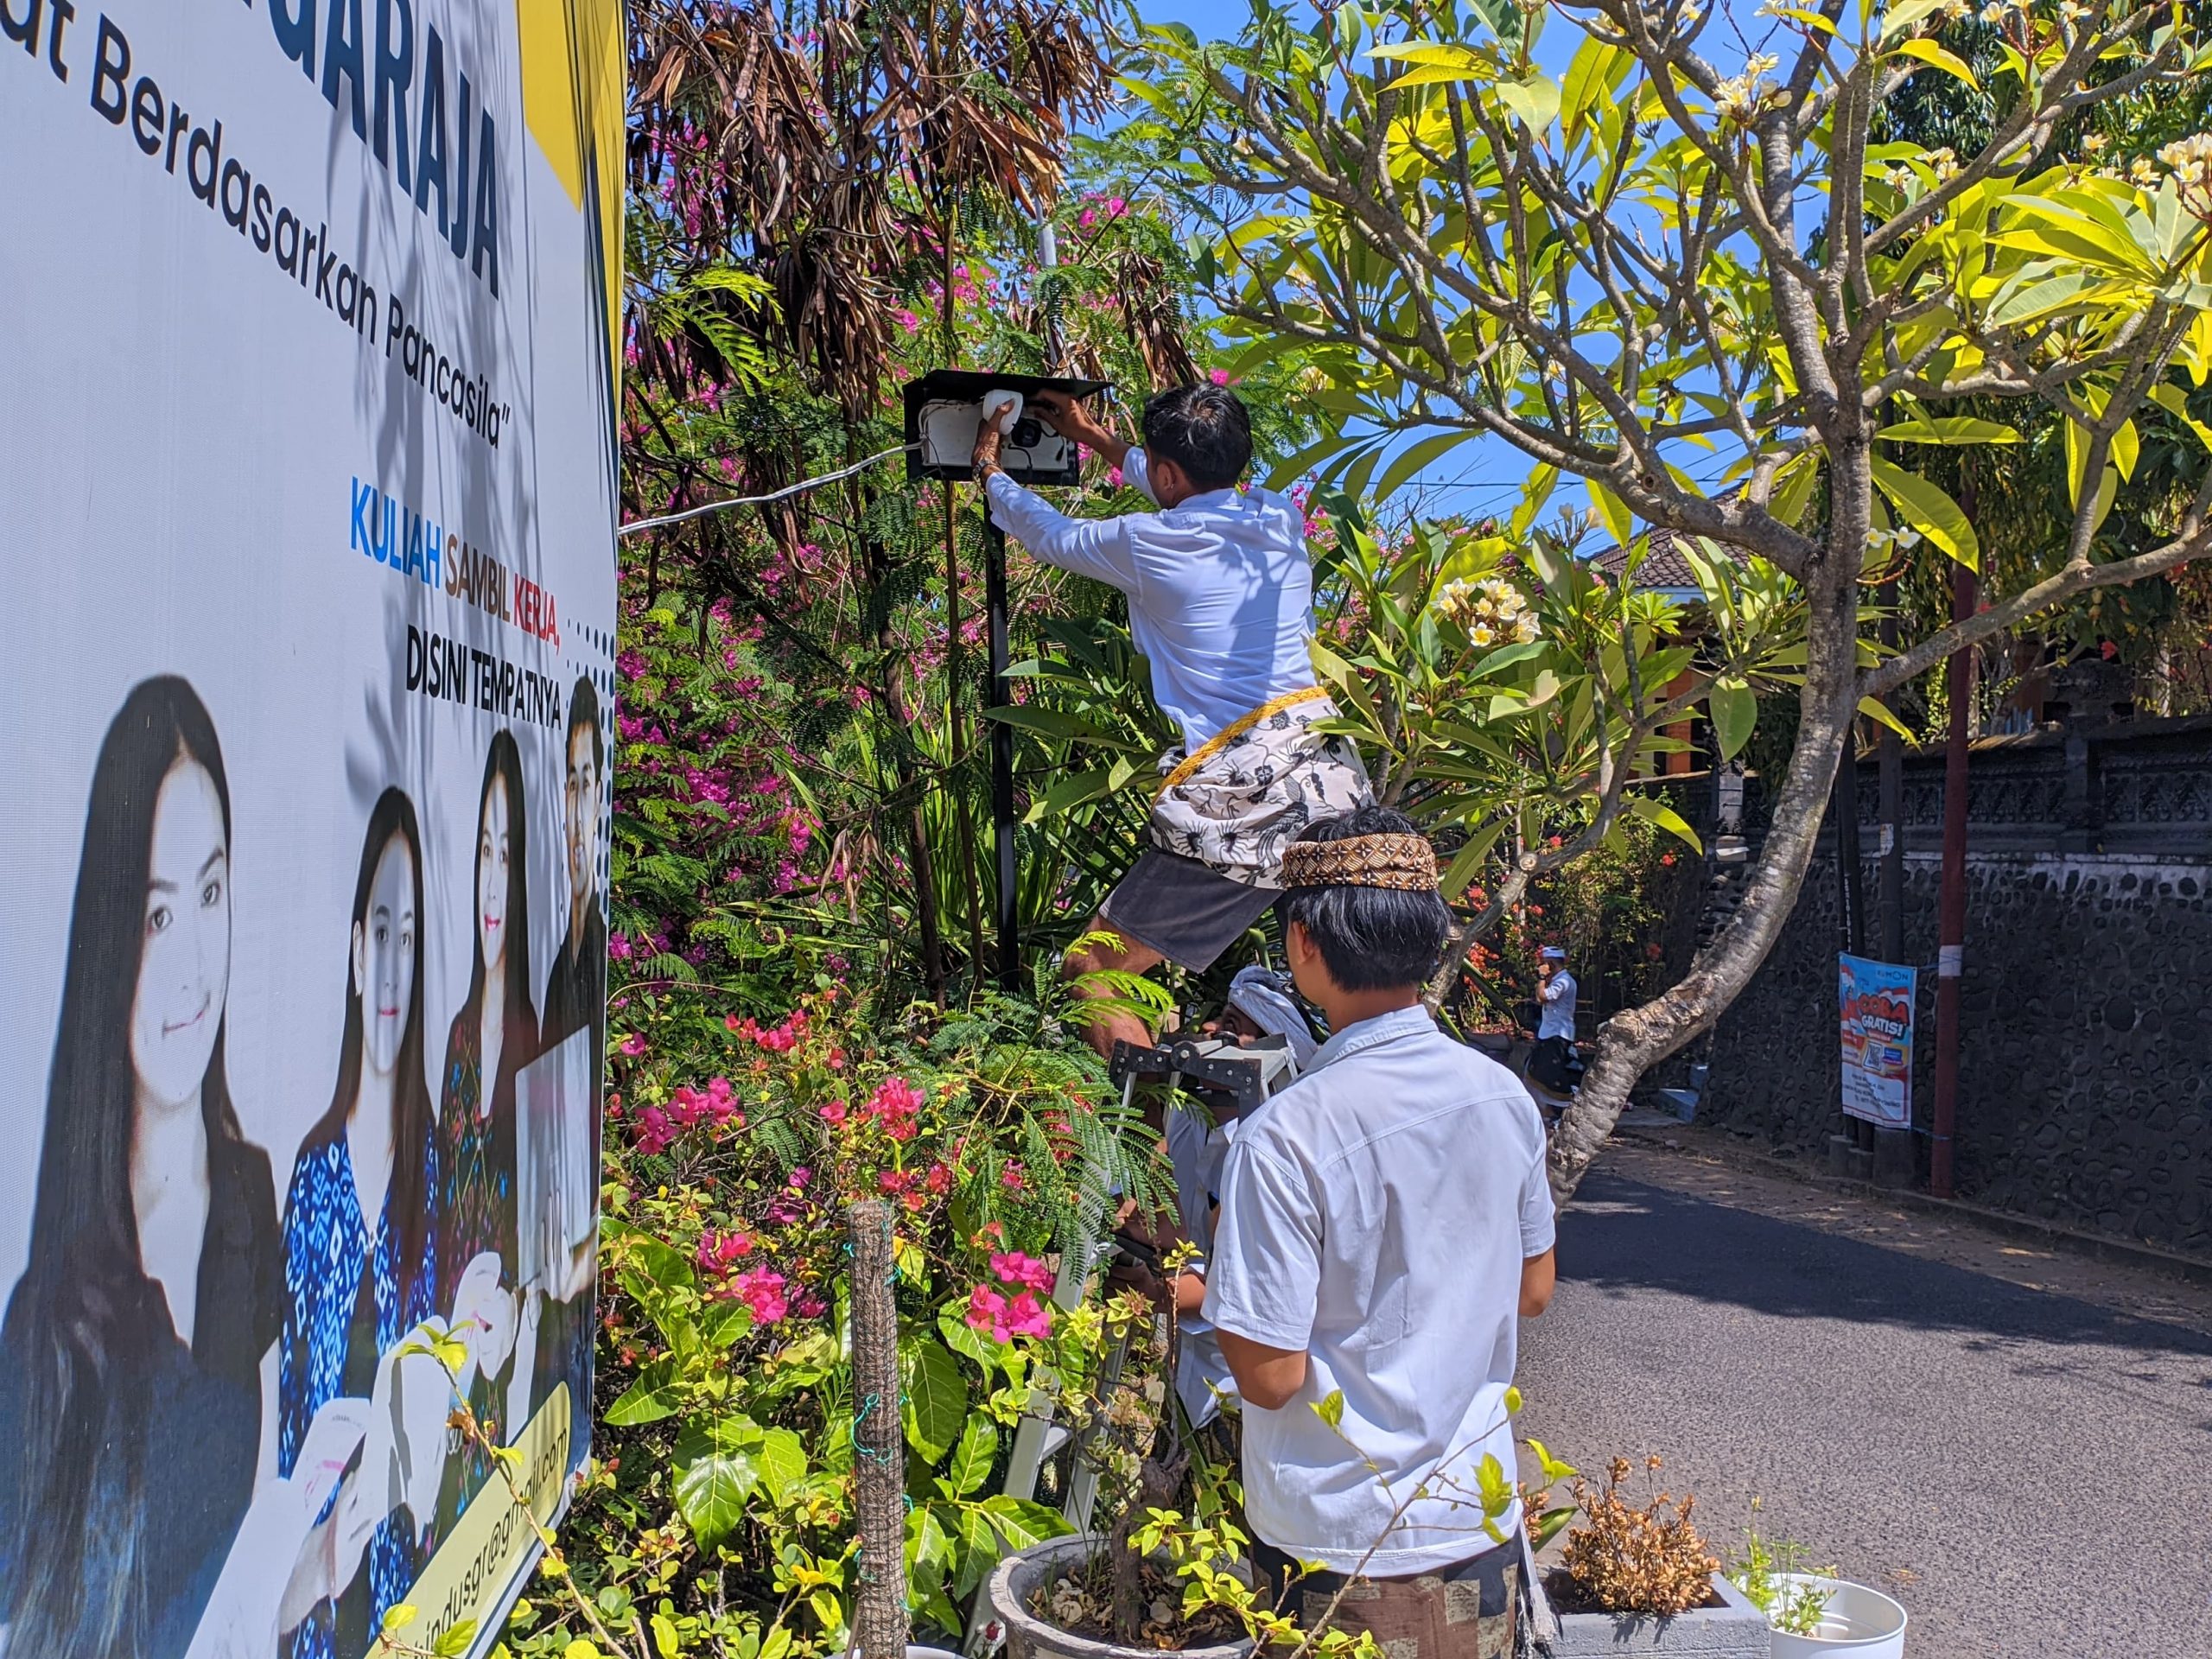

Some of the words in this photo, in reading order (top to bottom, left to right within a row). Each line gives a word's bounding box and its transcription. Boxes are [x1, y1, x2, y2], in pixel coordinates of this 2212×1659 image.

[91, 12, 378, 346] Berdasarkan
[385, 293, 511, 449] Pancasila"
[351, 475, 441, 588] KULIAH
[445, 533, 511, 622] SAMBIL
[513, 573, 561, 656] KERJA,
[406, 624, 467, 704] DISINI
[471, 648, 562, 730] TEMPATNYA
[1861, 1014, 1904, 1037] GRATIS!
